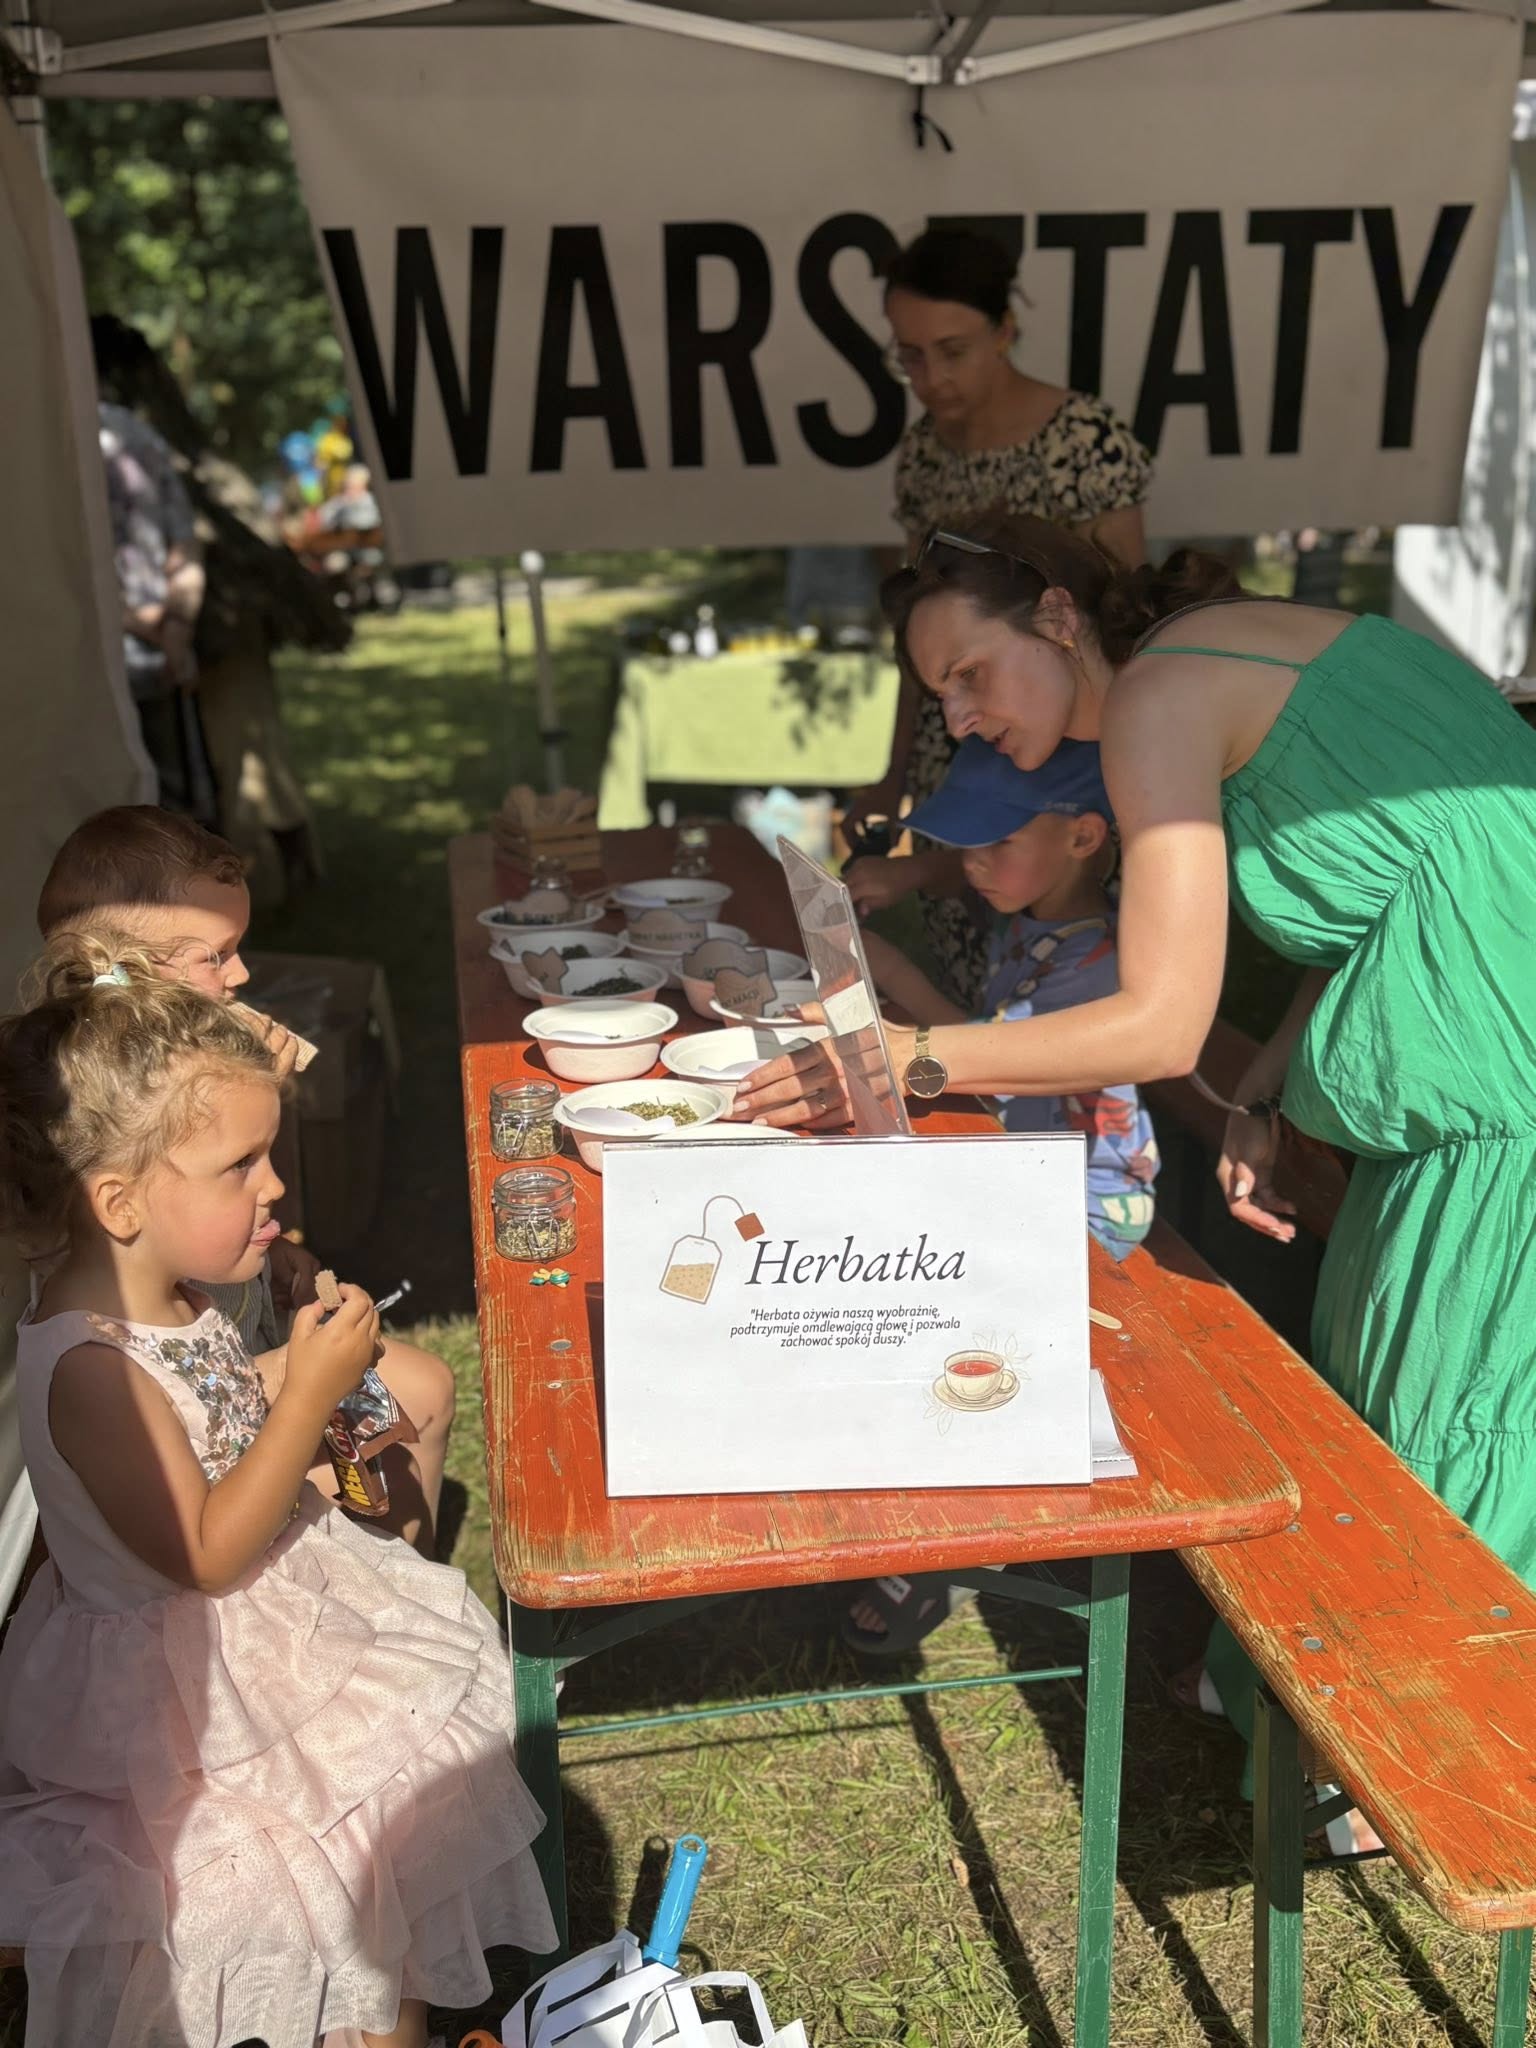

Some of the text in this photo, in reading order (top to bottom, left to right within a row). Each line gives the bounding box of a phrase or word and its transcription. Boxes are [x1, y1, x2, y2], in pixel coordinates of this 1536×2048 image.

[322, 204, 1475, 481] WARSTATY
[744, 1233, 967, 1285] Herbatka
[750, 1308, 800, 1321] "Herbata
[803, 1308, 840, 1322] ożywia
[842, 1309, 874, 1322] naszą
[730, 1322, 800, 1338] podtrzymuje
[802, 1319, 874, 1336] omdlewającą
[915, 1316, 961, 1333] pozwala
[780, 1331, 833, 1347] zachować
[835, 1332, 871, 1348] spokój
